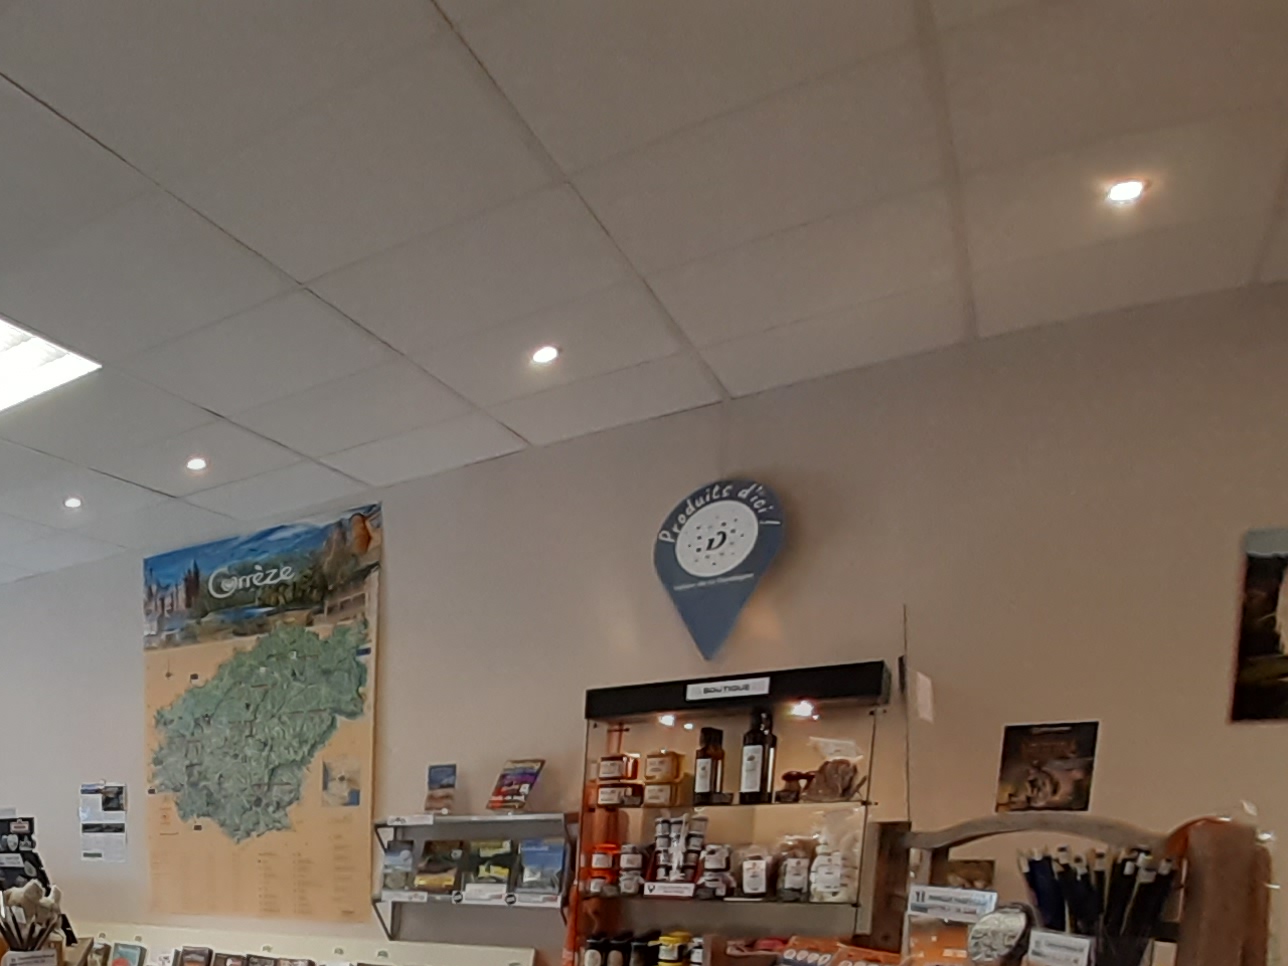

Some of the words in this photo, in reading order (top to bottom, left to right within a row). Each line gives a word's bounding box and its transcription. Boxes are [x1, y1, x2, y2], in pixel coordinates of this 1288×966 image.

[658, 485, 732, 542] Produits
[208, 564, 295, 598] Corrèze
[703, 684, 750, 694] BOUTIQUE
